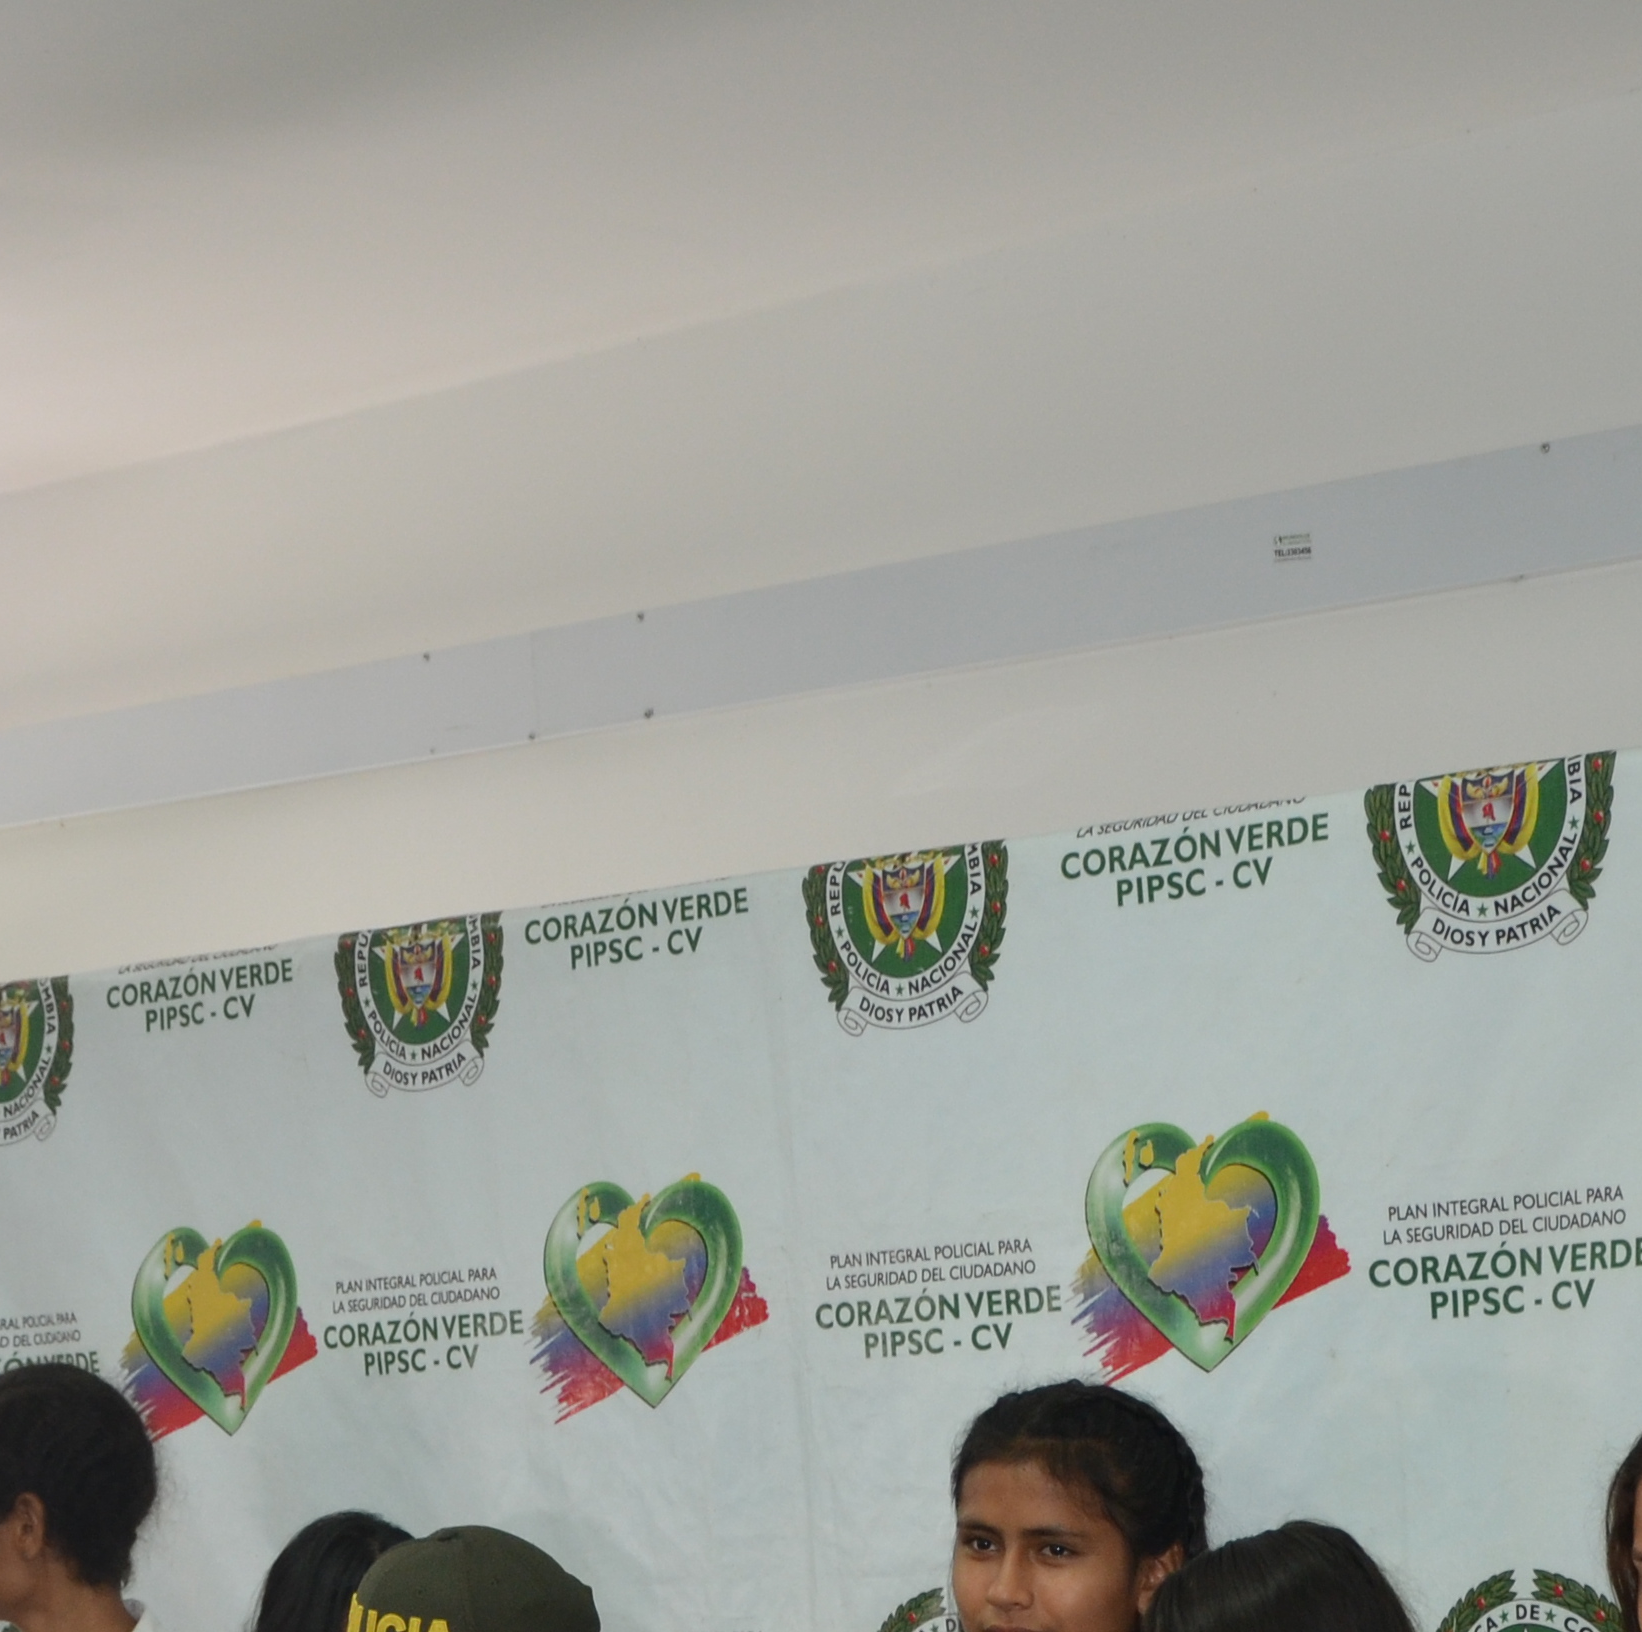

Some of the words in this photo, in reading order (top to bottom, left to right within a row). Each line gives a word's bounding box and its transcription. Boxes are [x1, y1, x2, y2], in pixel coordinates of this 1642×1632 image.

[1061, 827, 1221, 880] CORAZÓN
[1226, 812, 1329, 855] VERDE
[1116, 869, 1205, 907] PIPSC
[1233, 857, 1273, 889] CV
[1494, 832, 1577, 916] NACIONAL
[524, 898, 658, 945] CORAZÓN
[661, 888, 749, 924] VERDE
[1496, 904, 1561, 944] PATRIA
[570, 936, 643, 970] PIPSC
[668, 926, 703, 955] CV
[908, 921, 977, 995] NACIONAL
[106, 967, 216, 1009] CORAZÓN
[220, 958, 293, 990] VERDE
[146, 1002, 204, 1032] PIPSC
[223, 994, 255, 1019] CV
[909, 986, 963, 1022] PATRIA
[421, 993, 476, 1061] NACIONAL
[422, 1053, 466, 1083] PATRIA
[4, 1057, 51, 1118] NACIONAL
[4, 1110, 39, 1140] PATRIA
[1388, 1205, 1428, 1222] PLAN
[1432, 1197, 1509, 1218] INTEGRAL
[1513, 1190, 1582, 1211] POLICIAL
[1586, 1185, 1624, 1205] PARA
[1383, 1230, 1402, 1245] LA
[1406, 1221, 1494, 1244] SEGURIDAD
[1499, 1218, 1528, 1236] DEL
[1532, 1209, 1626, 1233] CIUDADANO
[830, 1255, 862, 1269] PLAN
[866, 1248, 930, 1266] INTEGRAL
[934, 1242, 994, 1261] POLICIAL
[998, 1238, 1032, 1255] PARA
[1368, 1241, 1542, 1288] CORAZÓN
[336, 1281, 363, 1294] PLAN
[366, 1275, 416, 1292] INTEGRAL
[420, 1271, 464, 1287] POLICIAL
[468, 1267, 497, 1282] PARA
[826, 1276, 841, 1291] LA
[844, 1270, 917, 1289] SEGURIDAD
[922, 1267, 945, 1283] DEL
[949, 1259, 1036, 1281] CIUDADANO
[333, 1301, 345, 1314] LA
[348, 1295, 406, 1313] SEGURIDAD
[410, 1292, 428, 1307] DEL
[431, 1286, 500, 1305] CIUDADANO
[815, 1288, 960, 1329] CORAZÓN
[964, 1285, 1062, 1318] VERDE
[1430, 1285, 1525, 1320] PIPSC
[1552, 1278, 1595, 1310] CV
[324, 1311, 438, 1349] CORAZÓN
[442, 1310, 523, 1339] VERDE
[864, 1328, 944, 1359] PIPSC
[971, 1322, 1013, 1351] CV
[364, 1348, 426, 1376] PIPSC
[447, 1344, 479, 1370] CV
[946, 1618, 957, 1632] D
[1516, 1604, 1540, 1620] DE
